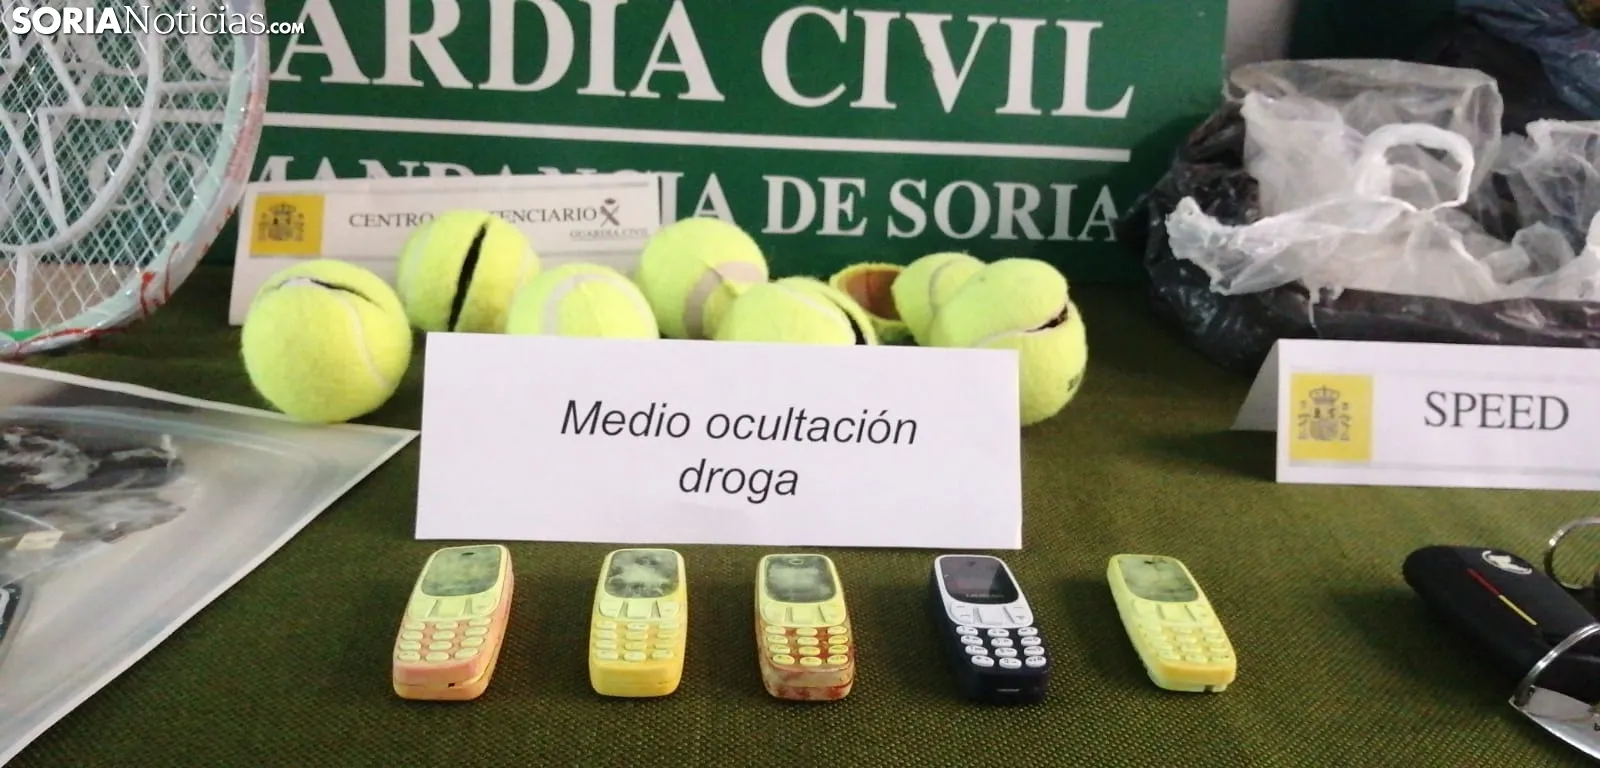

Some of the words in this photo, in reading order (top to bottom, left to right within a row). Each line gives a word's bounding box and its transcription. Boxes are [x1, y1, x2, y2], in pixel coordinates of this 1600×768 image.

[761, 6, 1135, 118] CIVIL
[349, 211, 435, 228] CENTRO
[488, 207, 598, 223] ENCIARIO
[761, 175, 868, 236] DE
[886, 179, 1118, 242] SORIA
[560, 399, 691, 438] Medio
[706, 406, 918, 445] ocultación
[1424, 391, 1569, 431] SPEED
[678, 458, 799, 504] droga
